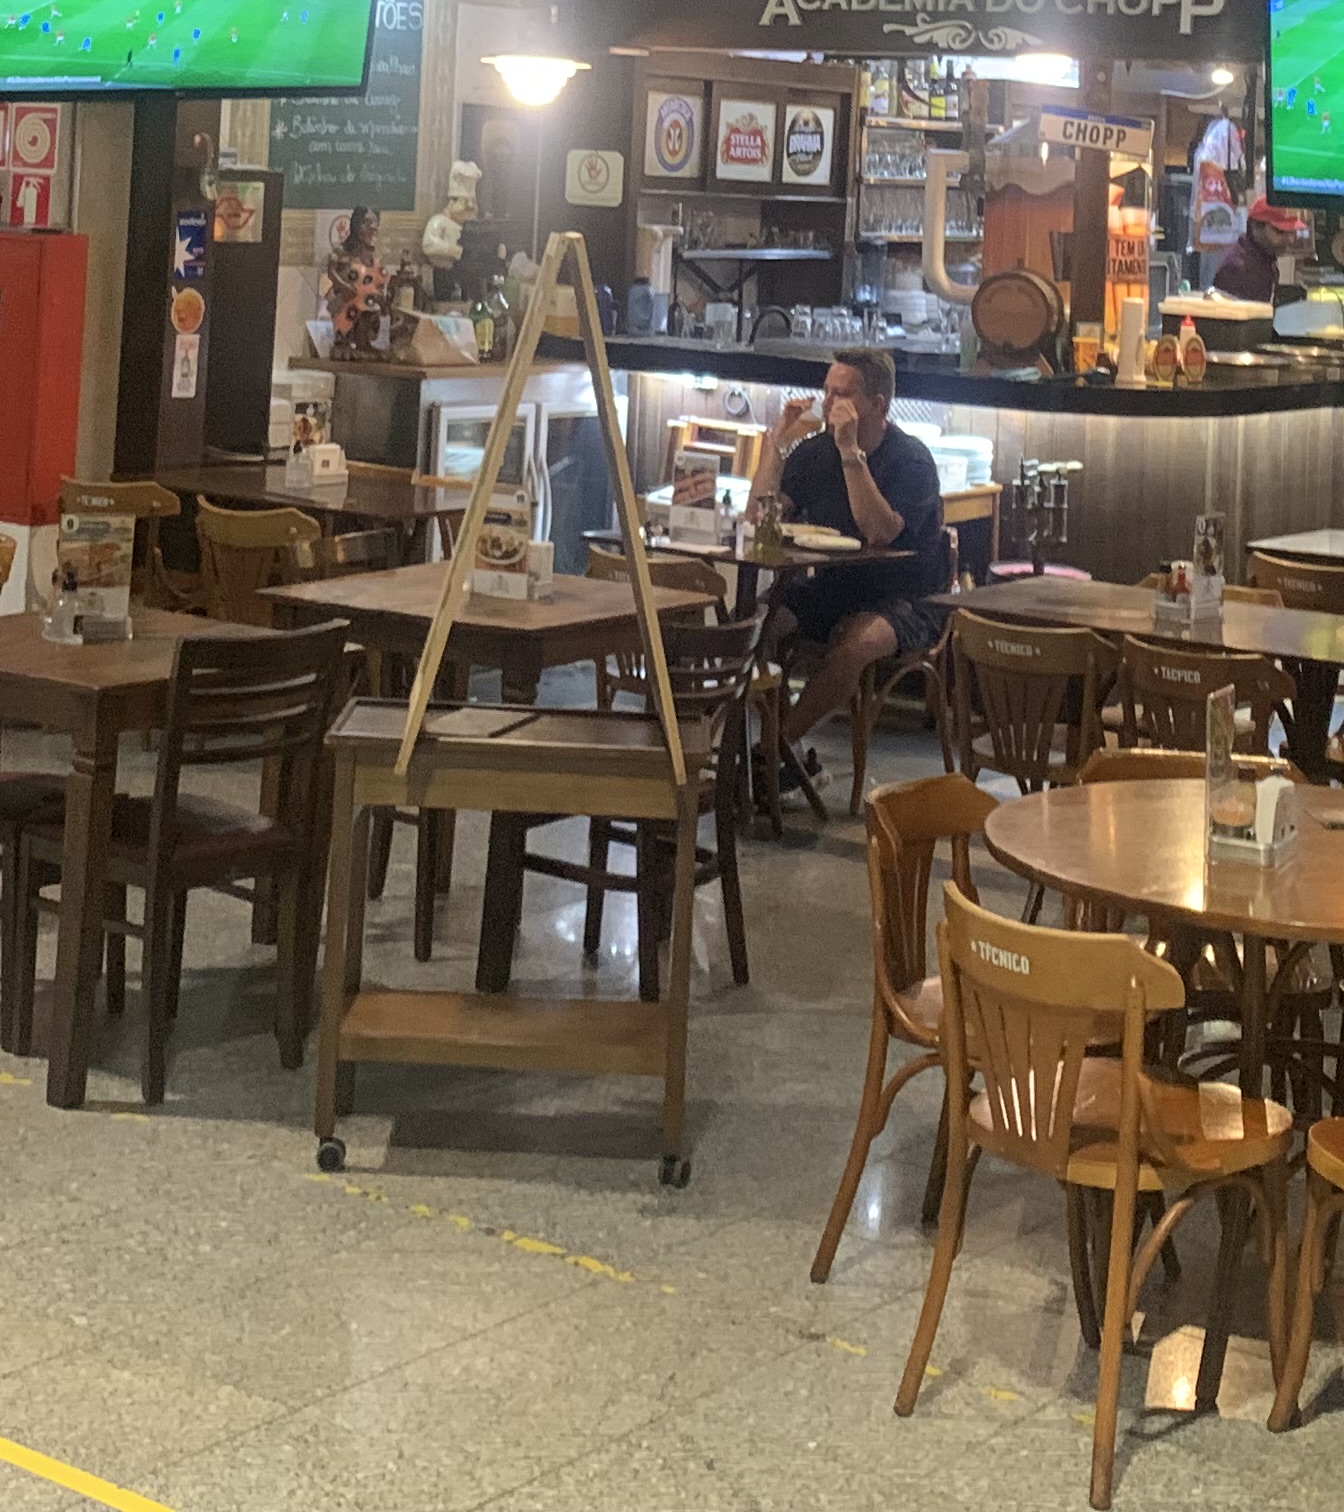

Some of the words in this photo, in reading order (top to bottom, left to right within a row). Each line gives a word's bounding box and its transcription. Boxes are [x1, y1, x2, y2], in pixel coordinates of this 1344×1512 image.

[730, 133, 762, 148] STELLA
[1063, 121, 1127, 148] CHOPP
[729, 147, 762, 159] ARTOIS
